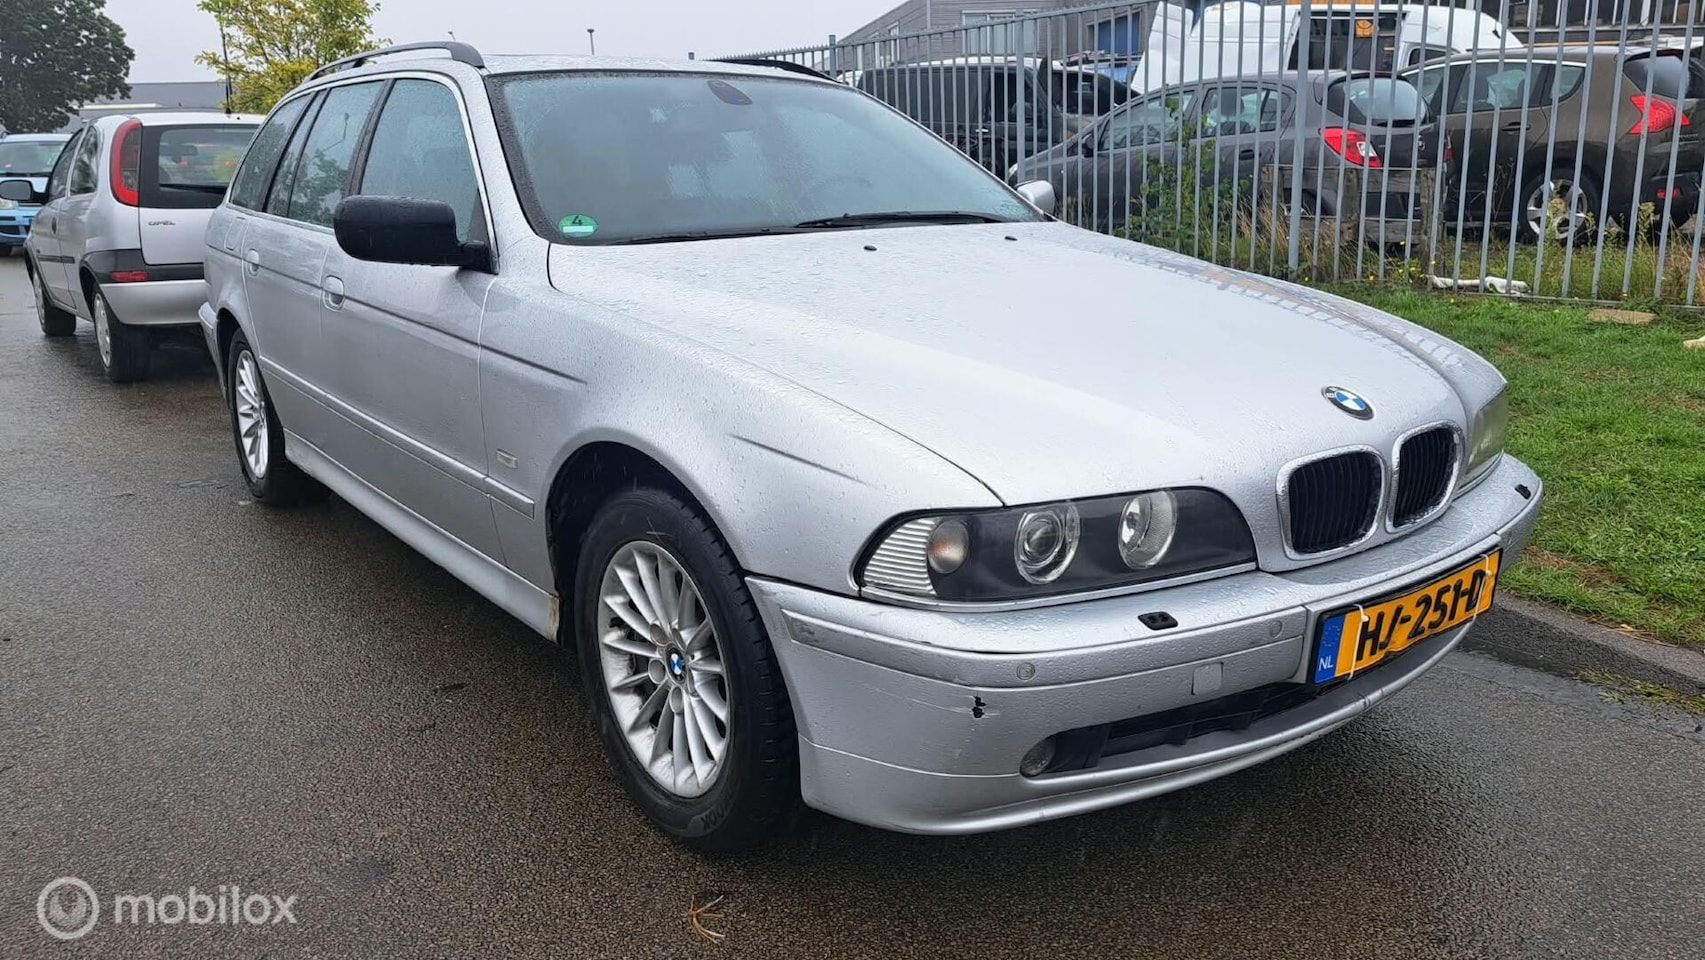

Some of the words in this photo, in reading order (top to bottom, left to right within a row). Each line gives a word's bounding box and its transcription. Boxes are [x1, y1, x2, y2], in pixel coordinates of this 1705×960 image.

[571, 215, 583, 226] 4
[1356, 570, 1486, 661] HJ-251-D
[1318, 654, 1334, 672] NL
